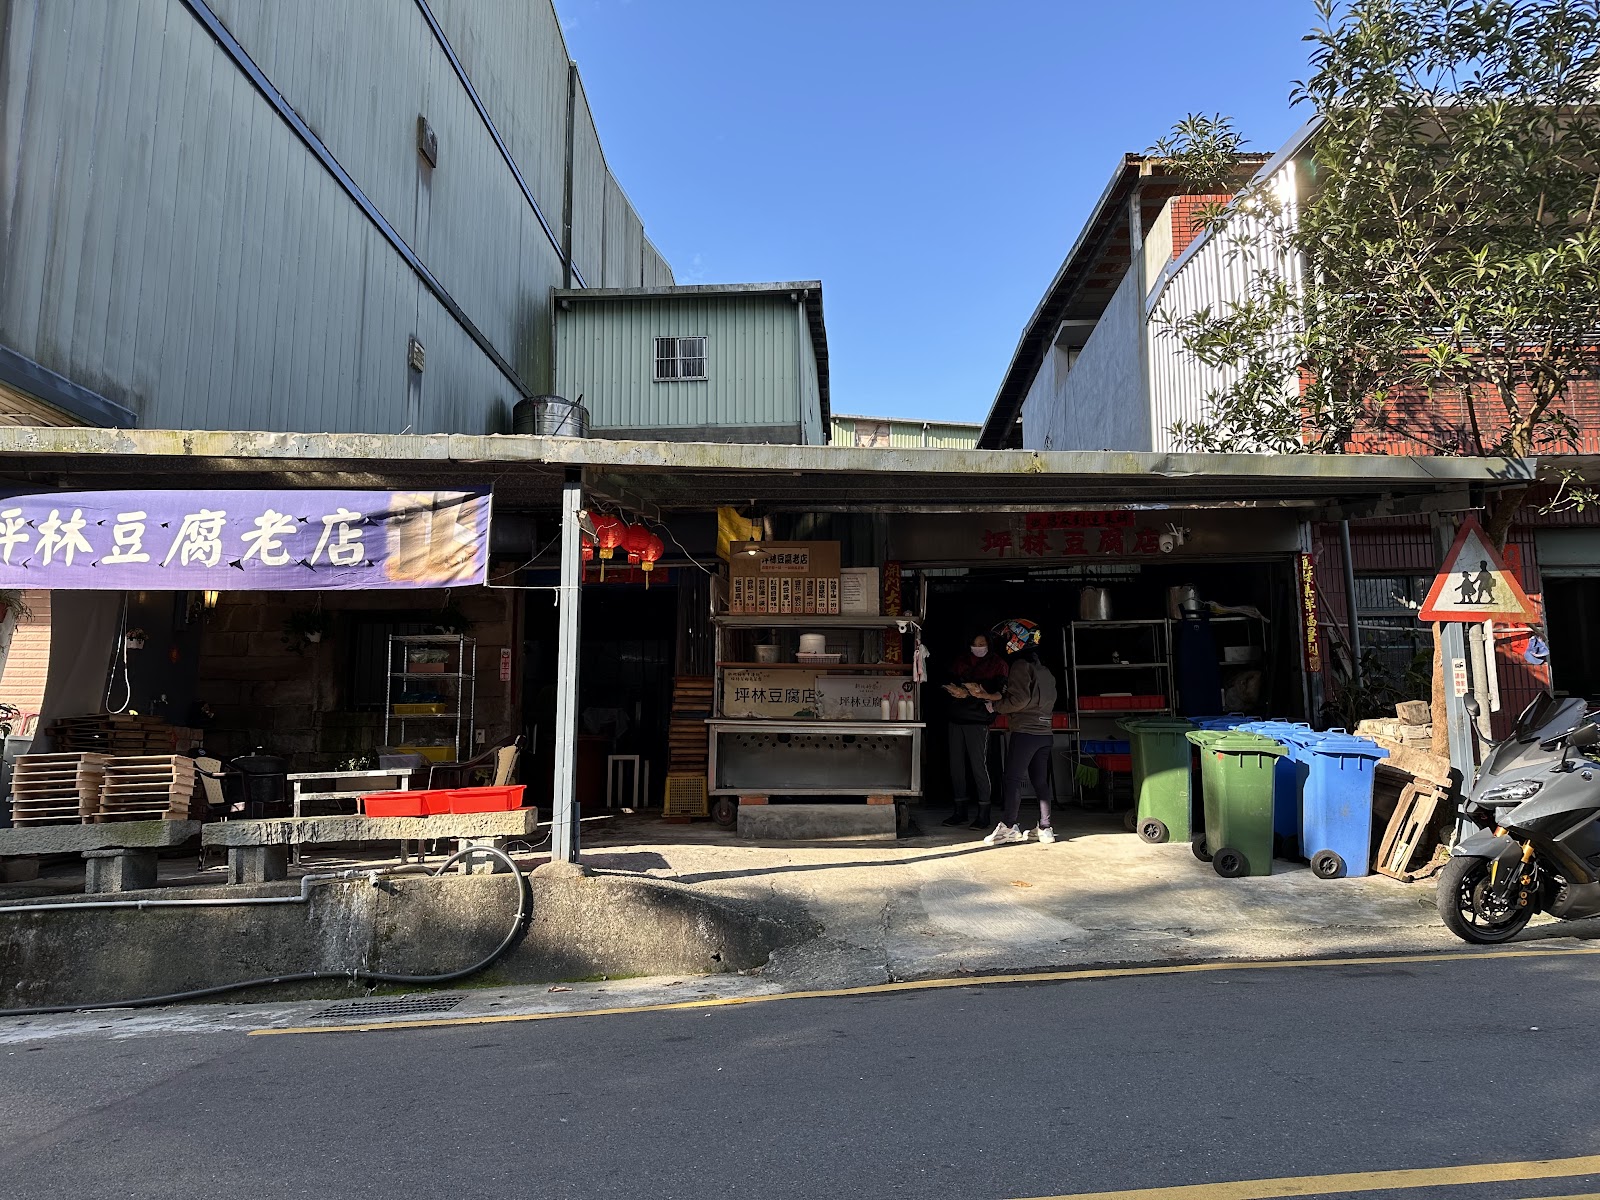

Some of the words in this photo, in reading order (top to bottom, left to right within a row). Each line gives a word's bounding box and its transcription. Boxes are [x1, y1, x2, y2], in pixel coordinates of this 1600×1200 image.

[980, 528, 1160, 557] 坪林豆腐店
[734, 688, 815, 704] 坪林豆腐店
